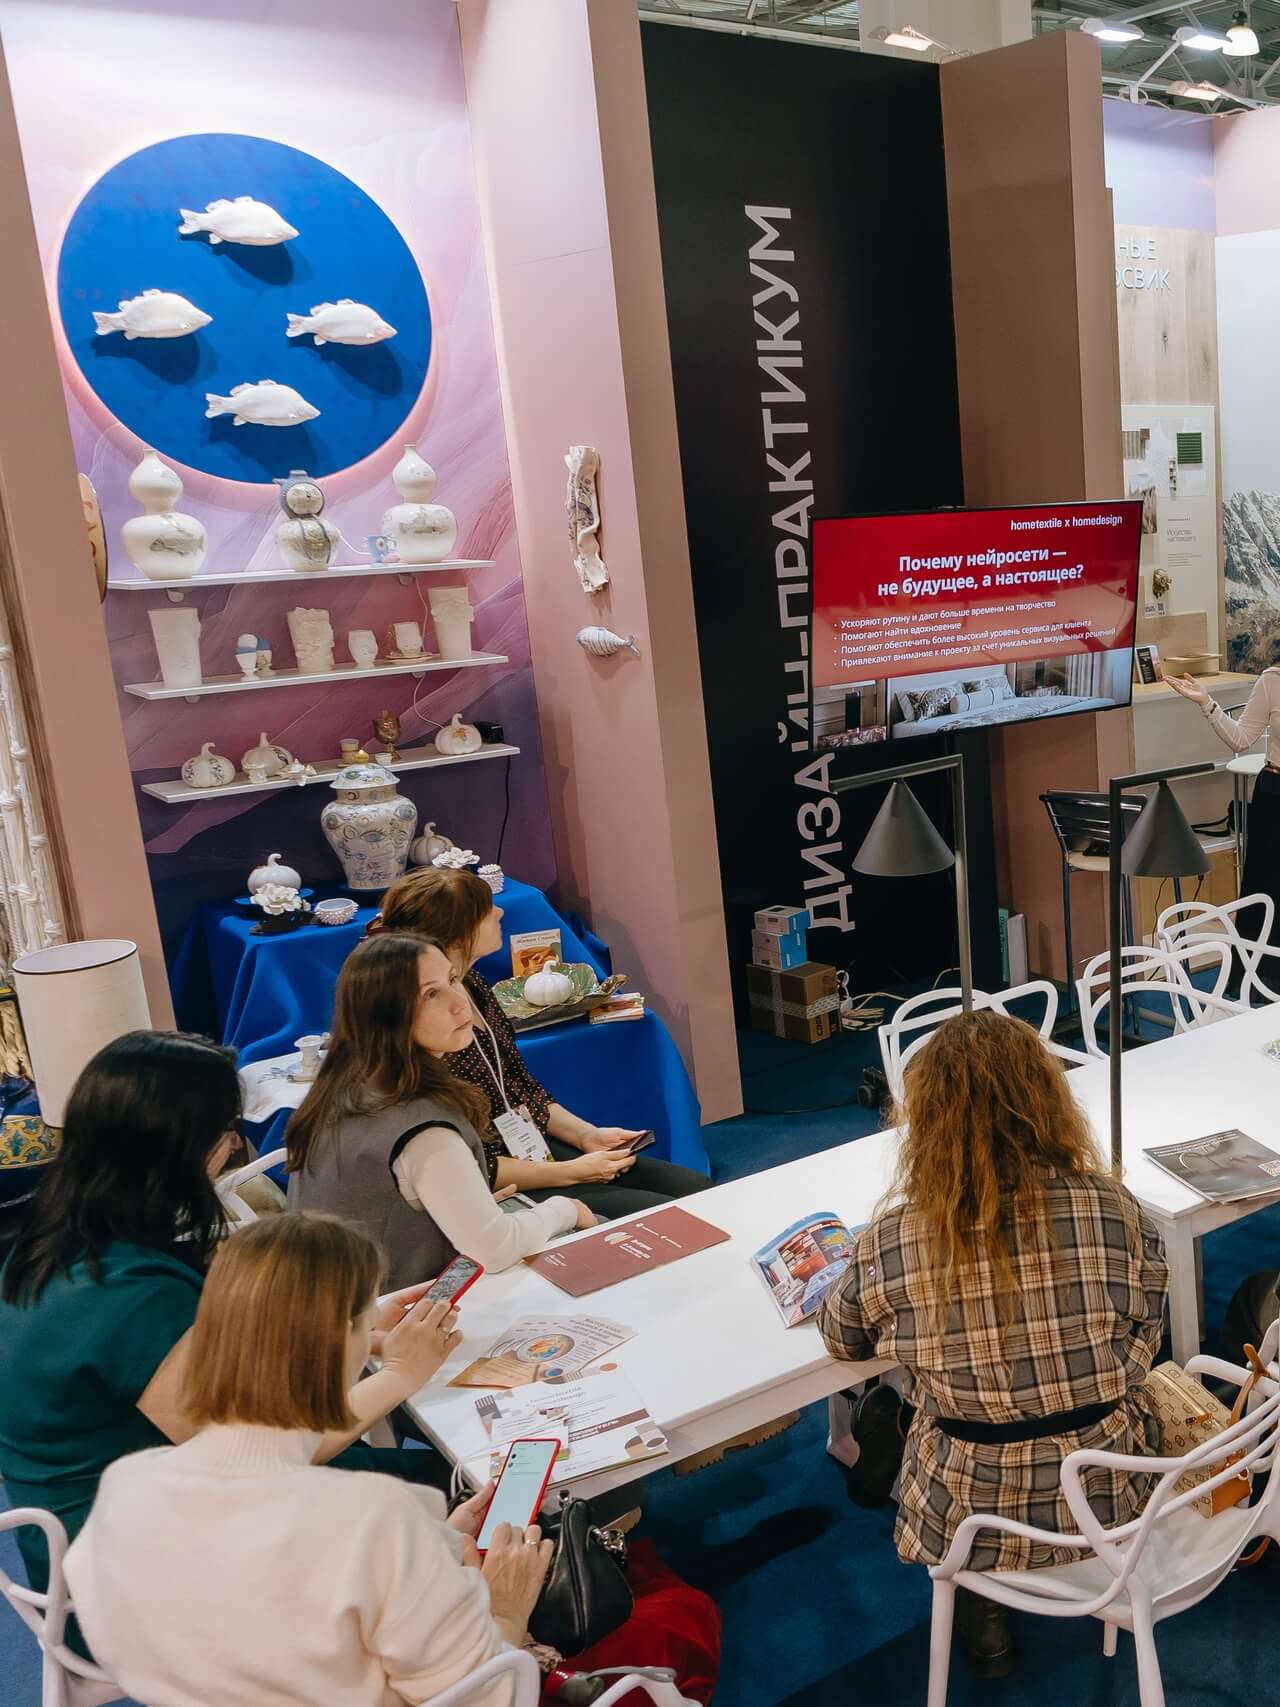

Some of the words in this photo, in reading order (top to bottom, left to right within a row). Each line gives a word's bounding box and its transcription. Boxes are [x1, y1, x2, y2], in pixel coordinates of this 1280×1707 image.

[1010, 517, 1062, 531] hometextile
[1072, 514, 1123, 528] homedesign
[899, 555, 963, 572] Почему
[966, 548, 1049, 569] нейросети
[878, 582, 898, 596] не
[902, 577, 978, 598] будущее,
[982, 574, 992, 587] а
[995, 563, 1084, 586] настоящее?
[841, 617, 880, 629] Ускоряют
[882, 615, 911, 626] рутину
[918, 612, 939, 622] дают
[940, 608, 970, 619] больше
[971, 606, 1004, 617] времени
[1016, 600, 1056, 612] творчество
[841, 630, 882, 641] Помогают
[884, 627, 909, 637] найти
[910, 622, 962, 635] вдохновение
[841, 643, 882, 654] Помогают
[884, 637, 931, 650] обеспечить
[932, 635, 956, 644] более
[956, 630, 989, 642] высокий
[990, 628, 1020, 639] уровень
[1021, 624, 1050, 635] сервиса
[1050, 622, 1064, 632] для
[1064, 619, 1091, 629] клиента
[841, 655, 891, 668] Привлекают
[893, 650, 933, 661] внимание
[940, 645, 971, 657] проекту
[981, 641, 998, 651] счет
[999, 635, 1043, 649] уникальных
[1043, 631, 1085, 645] визуальных
[1085, 627, 1115, 640] решений
